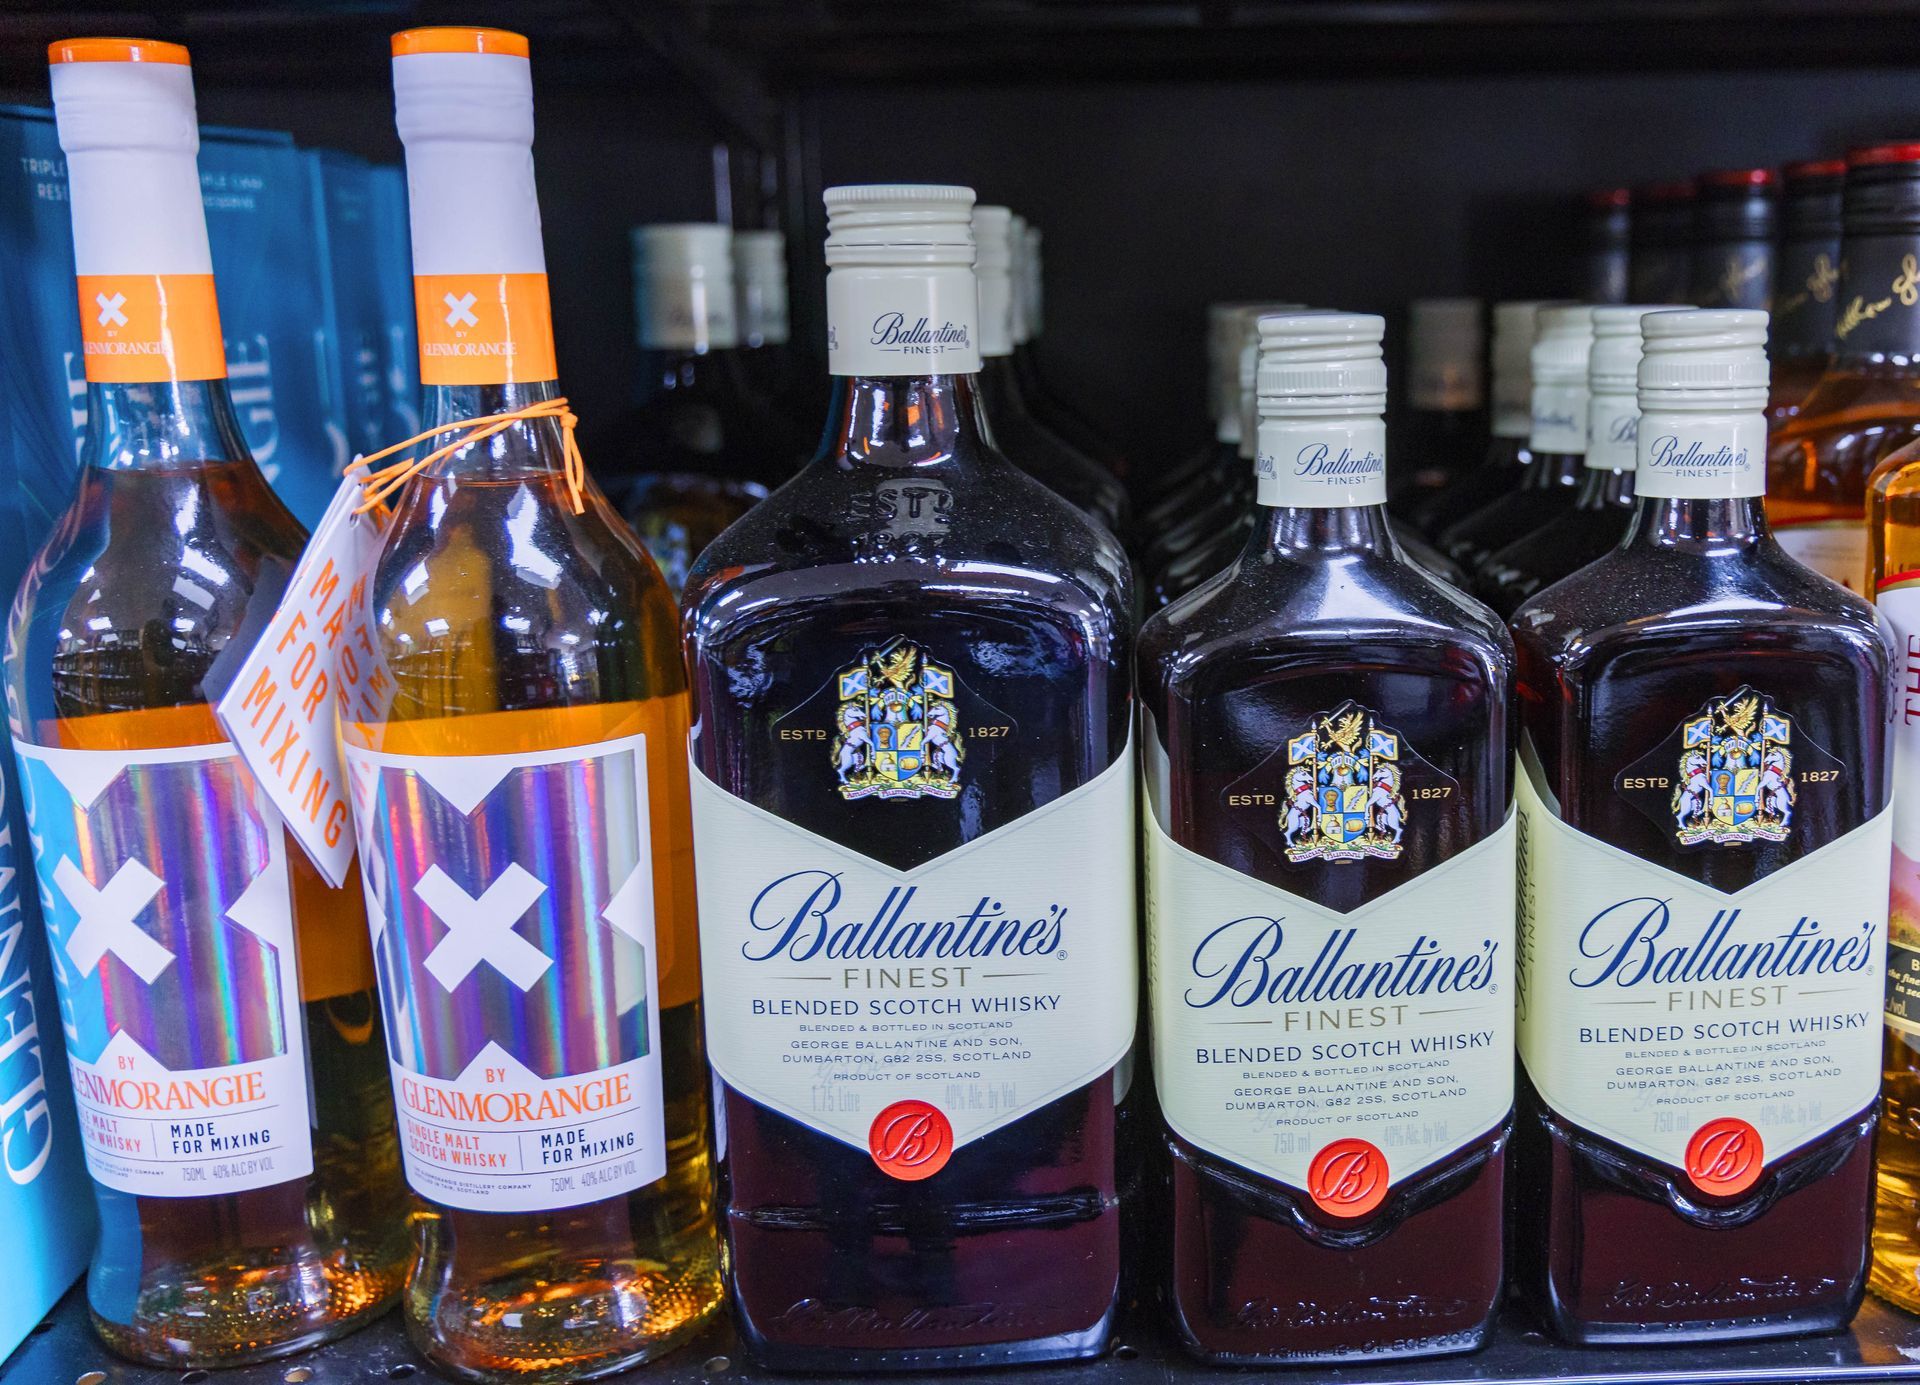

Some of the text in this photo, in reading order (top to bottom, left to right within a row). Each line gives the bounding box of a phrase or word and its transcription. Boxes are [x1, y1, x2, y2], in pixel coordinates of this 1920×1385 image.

[870, 312, 967, 345] Ballantine's
[423, 341, 517, 356] GLENMORANGIE
[904, 345, 945, 354] FINEST
[1648, 435, 1747, 467] Ballantine's
[1327, 476, 1367, 485] FINEST
[1675, 469, 1719, 478] FINEST
[276, 610, 329, 724] FOR
[780, 727, 1010, 740] ESTD 1827
[241, 665, 347, 849] MIXING
[1624, 770, 1839, 789] ESTD 1827
[1229, 788, 1451, 806] ESTD 1827
[742, 870, 1067, 962] Ballantine's
[1528, 879, 1536, 962] FINEST
[1569, 897, 1876, 988] Ballantine's
[1184, 916, 1498, 1008] Ballantine's
[843, 967, 972, 990] FINEST
[1895, 983, 1905, 993] in
[752, 995, 1061, 1015] BLENDED SCOTCH WHISKY
[1668, 985, 1788, 1011] FINEST
[799, 1021, 1013, 1032] BLENDED & BOTTLED IN SCOTLAND
[1284, 1005, 1409, 1031] FINEST
[1580, 1012, 1869, 1043] BLENDED SCOTCH WHISKY
[791, 1037, 1023, 1049] GEORGE BALLANTINE AND SON,
[1197, 1030, 1494, 1063] BLENDED SCOTCH WHISKY
[1625, 1050, 1679, 1059] BLENDED
[1683, 1049, 1691, 1057] &
[1695, 1046, 1747, 1056] BOTTLED
[1766, 1040, 1826, 1051] SCOTLAND
[118, 1055, 135, 1071] BY
[782, 1051, 1031, 1064] DUMBARTON, G82 2SS, SCOTLAND
[1616, 1055, 1834, 1076] GEORGE BALLANTINE AND SON,
[485, 1068, 506, 1083] BY
[896, 1073, 911, 1081] OF
[916, 1071, 981, 1080] SCOTLAND
[1243, 1070, 1298, 1079] BLENDED
[1314, 1066, 1368, 1077] BOTTLED
[1372, 1065, 1384, 1073] IN
[1387, 1059, 1450, 1072] SCOTLAND
[1607, 1068, 1842, 1090] DUMBARTON, G82 2SS, SCOTLAND
[1234, 1075, 1459, 1097] GEORGE BALLANTINE AND SON,
[402, 1073, 631, 1123] GLENMORANGIE
[1225, 1087, 1467, 1111] DUMBARTON, G82 2SS, SCOTLAND
[1656, 1090, 1795, 1105] PRODUCT OF SCOTLAND
[92, 1115, 118, 1133] MALT
[1276, 1110, 1419, 1126] PRODUCT OF SCOTLAND
[170, 1122, 216, 1138] MADE
[408, 1119, 480, 1151] SINGLE MALT
[541, 1128, 586, 1149] MADE
[98, 1133, 142, 1153] WHISKY
[172, 1129, 271, 1155] FOR MIXING
[410, 1136, 507, 1168] SCOTCH WHISKY
[543, 1132, 635, 1165] FOR MIXING
[182, 1166, 207, 1182] 750ML
[212, 1156, 275, 1179] 40% ALC BY VOL
[581, 1160, 637, 1187] 40% ALC BY VOL
[551, 1177, 576, 1192] 750ML
